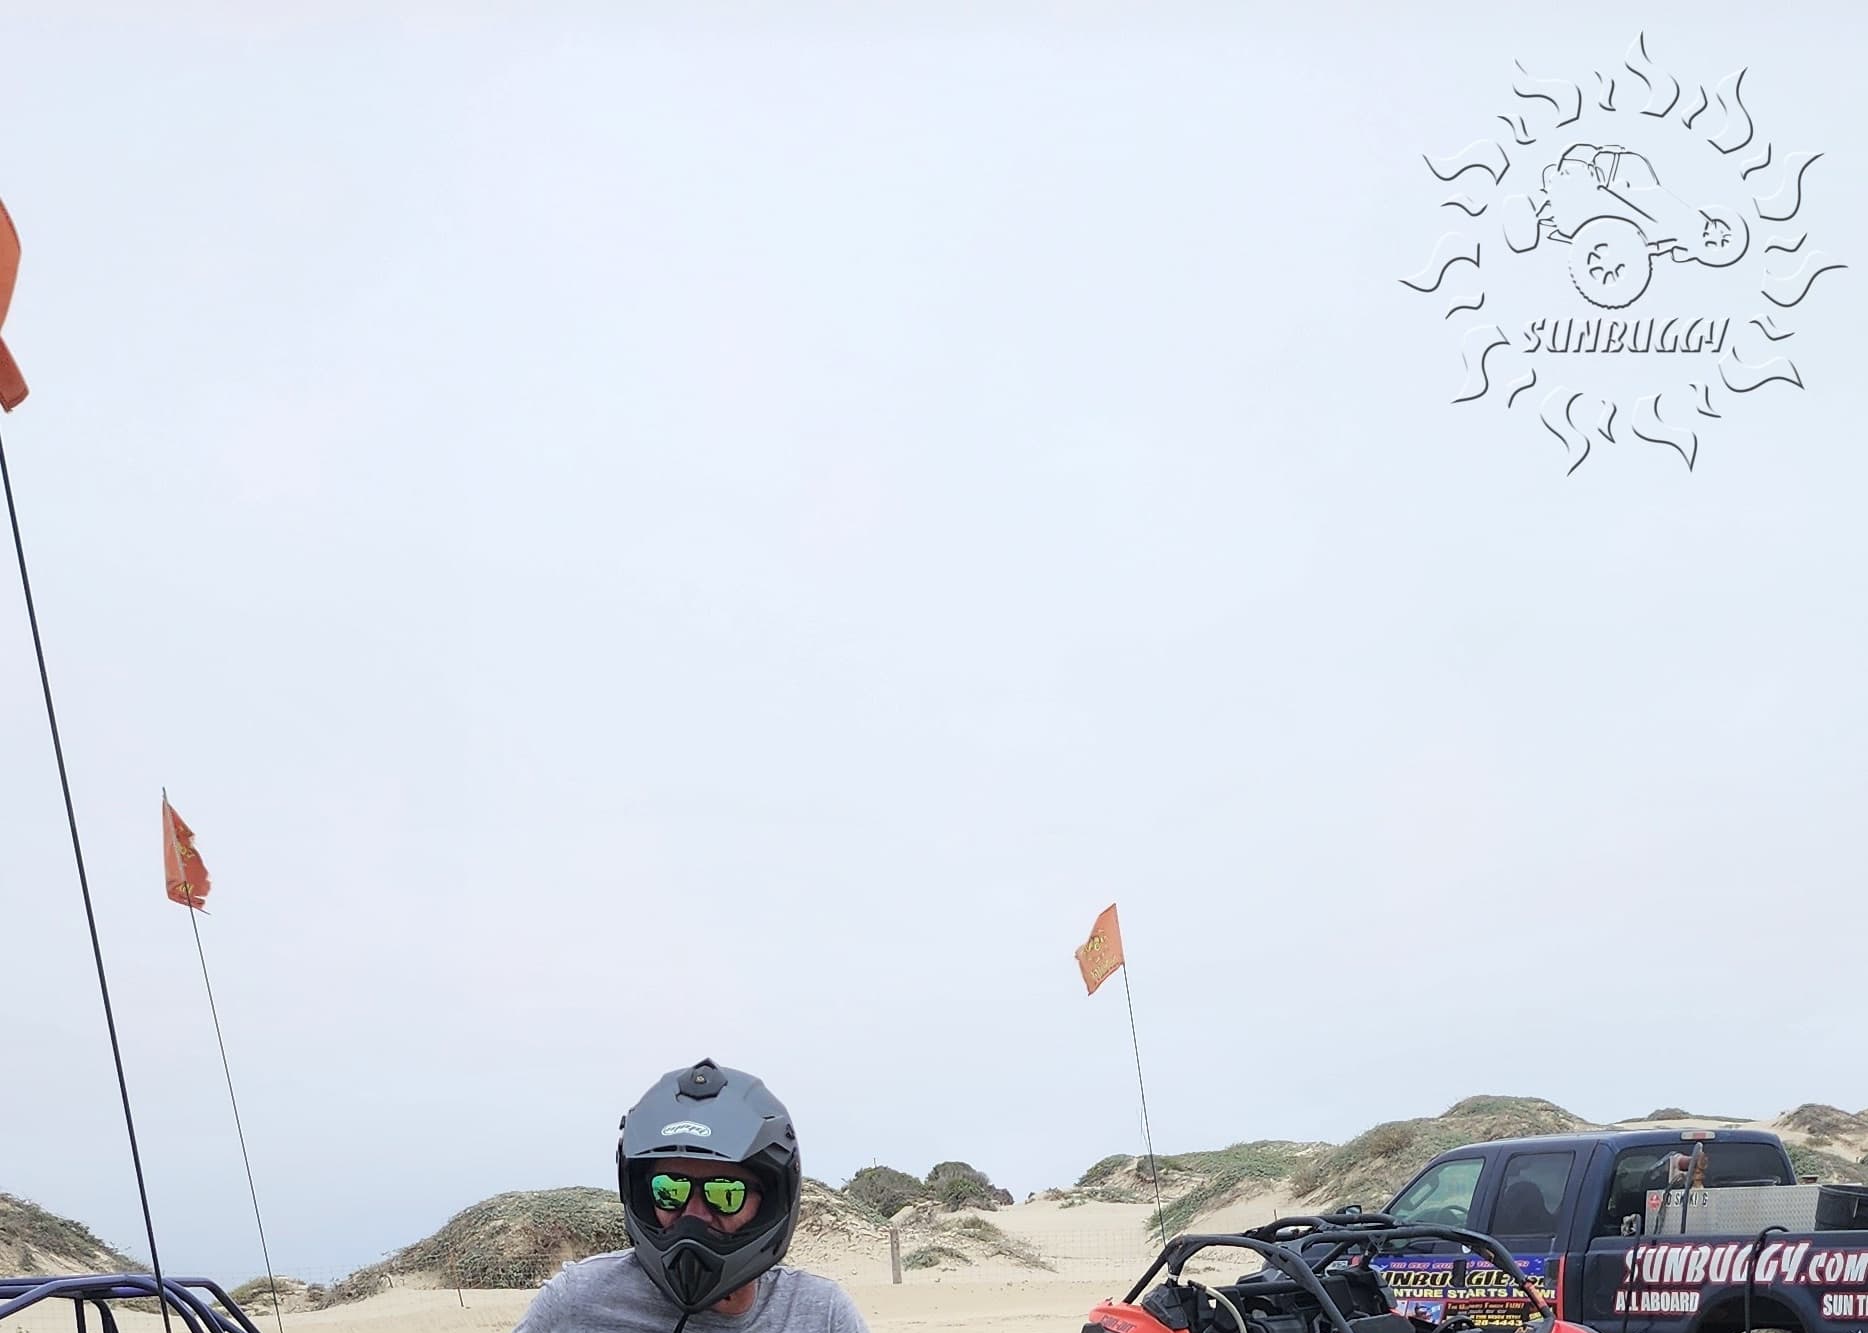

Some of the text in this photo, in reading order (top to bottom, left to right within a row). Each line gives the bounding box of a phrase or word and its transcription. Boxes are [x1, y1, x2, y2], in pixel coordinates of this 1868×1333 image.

[1447, 1288, 1508, 1299] STARTS
[1641, 1291, 1700, 1312] ABOARD
[1823, 1293, 1854, 1317] SUN
